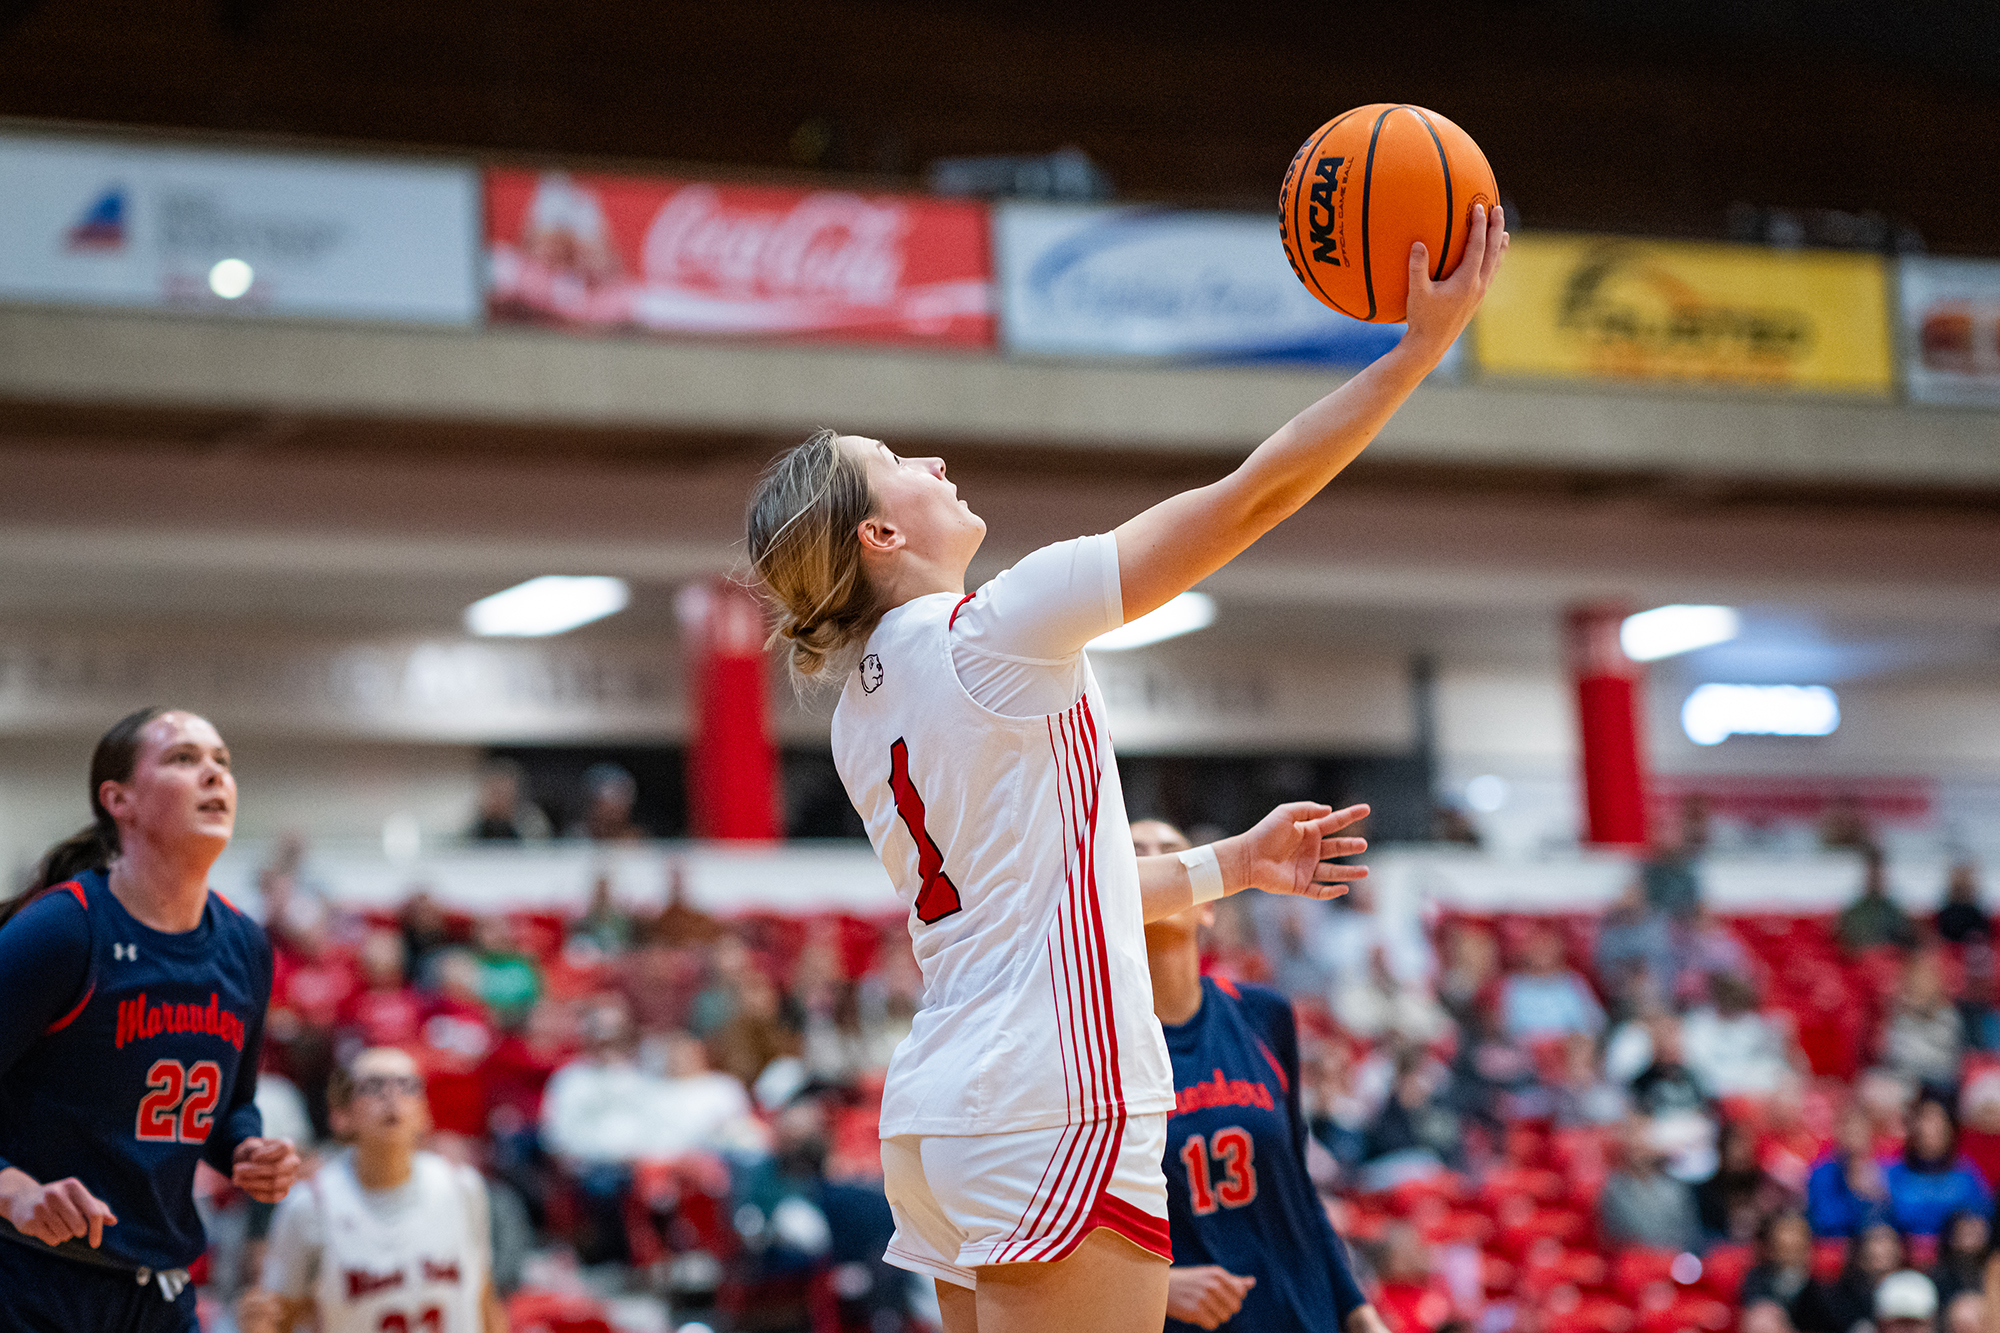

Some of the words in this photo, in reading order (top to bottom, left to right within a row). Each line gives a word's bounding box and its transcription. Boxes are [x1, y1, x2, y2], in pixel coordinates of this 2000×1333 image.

[1308, 156, 1346, 267] NCAA
[1338, 186, 1347, 219] GAME
[1342, 156, 1355, 184] BALL
[887, 735, 962, 926] 1
[135, 1058, 223, 1146] 22
[1179, 1125, 1259, 1216] 13
